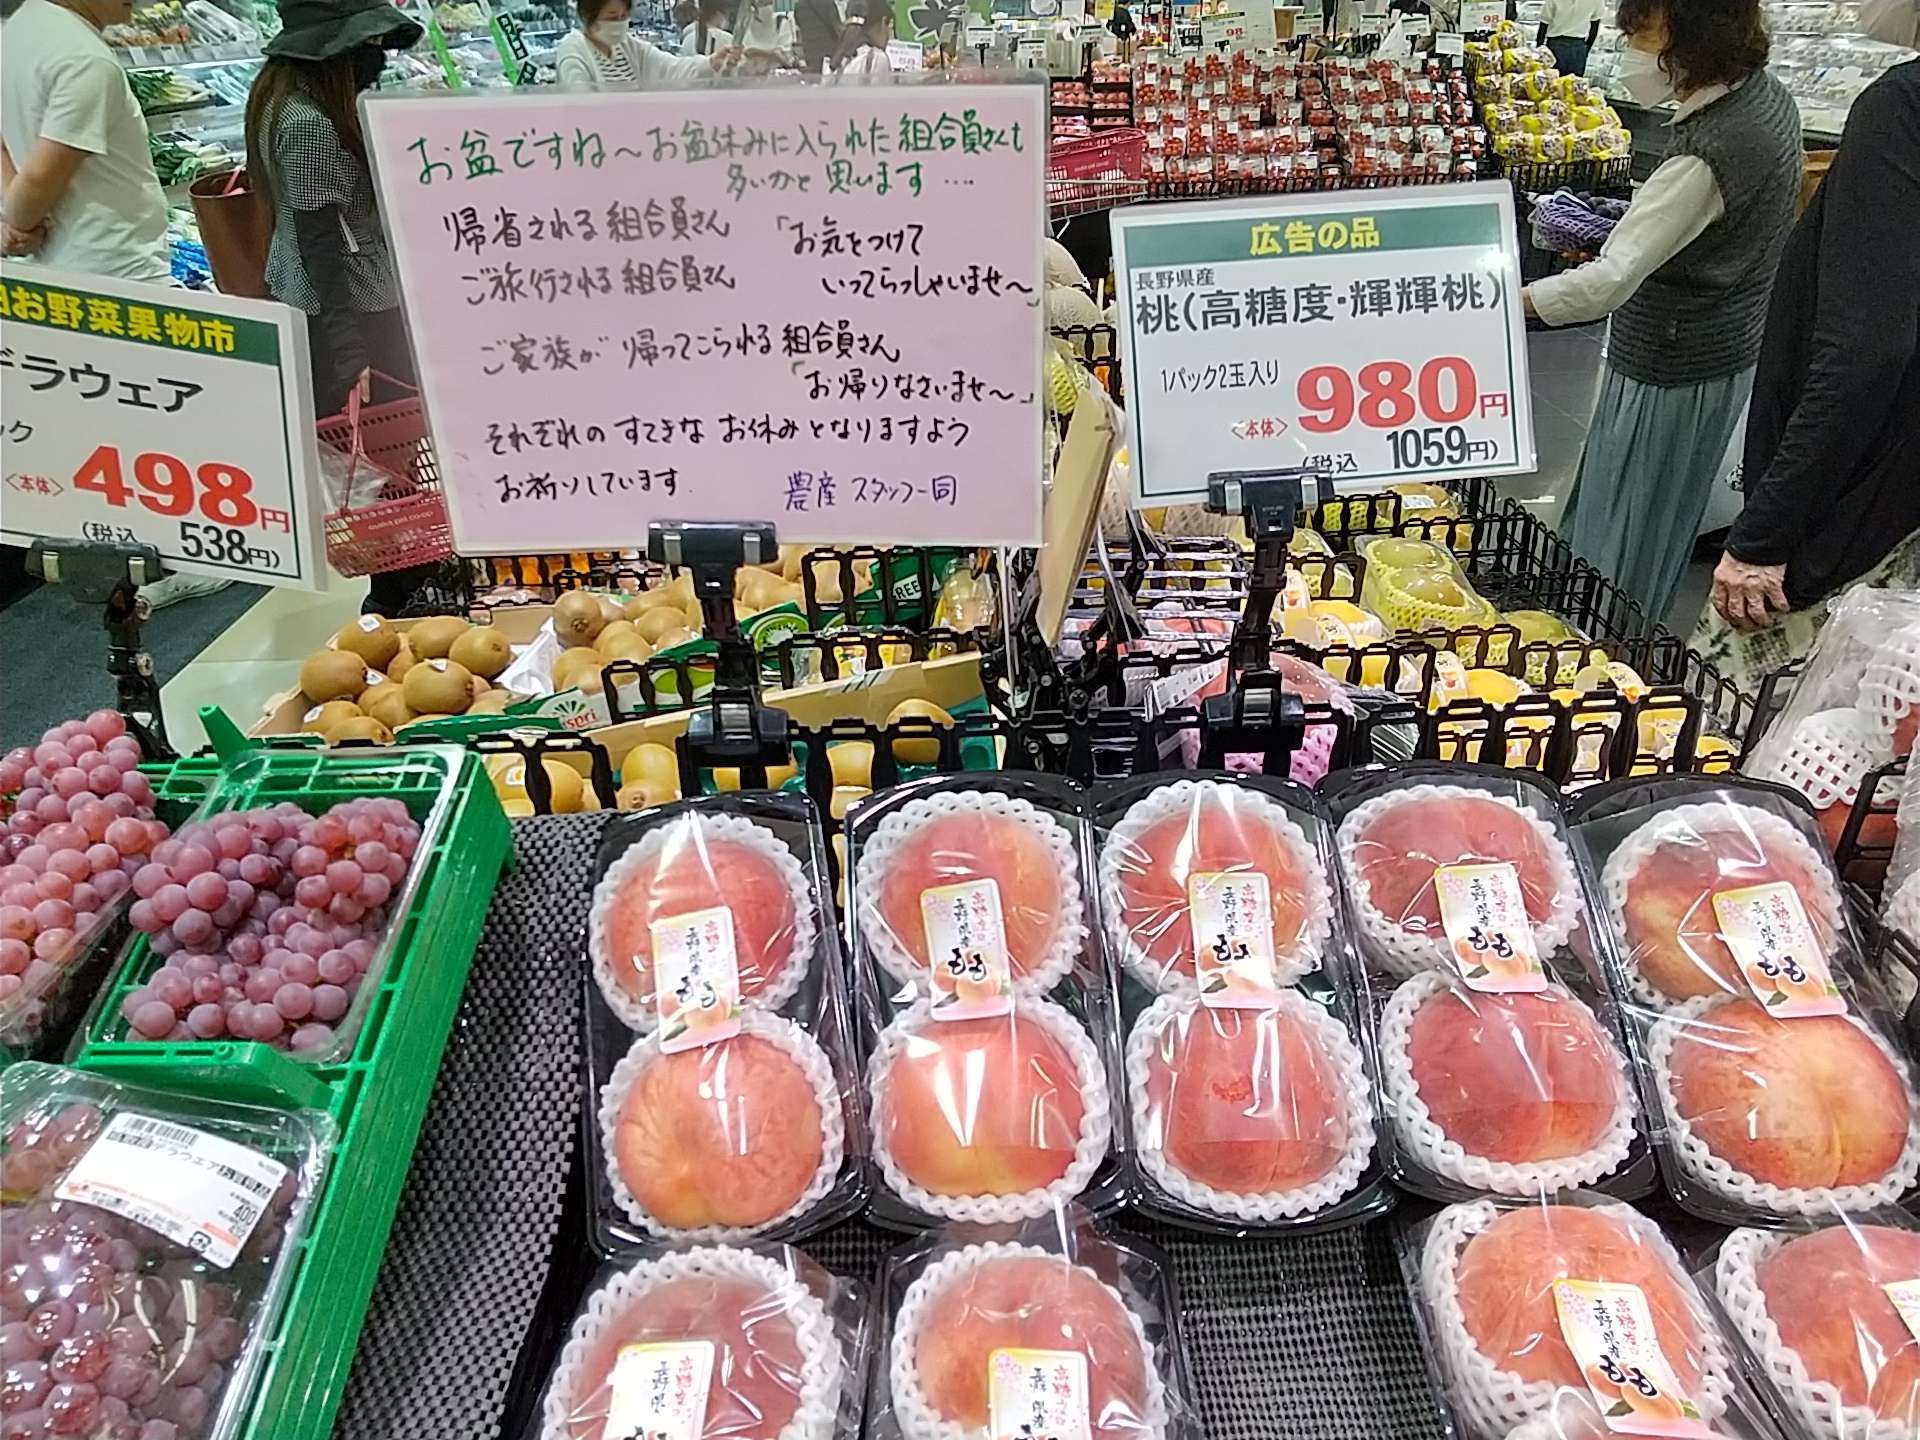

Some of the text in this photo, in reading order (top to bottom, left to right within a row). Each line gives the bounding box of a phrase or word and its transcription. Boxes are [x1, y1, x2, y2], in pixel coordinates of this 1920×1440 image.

[1249, 216, 1380, 256] 広告の品
[1135, 267, 1216, 291] 長野県産
[1135, 271, 1502, 335] 桃(高糖度・輝輝桃)
[1161, 360, 1280, 393] 1パック2玉入り
[0, 419, 34, 444] ク
[1467, 925, 1514, 958] もも
[947, 947, 987, 982] もも
[1757, 949, 1806, 983] もも
[233, 1204, 258, 1226] 400
[1598, 1354, 1658, 1397] もも
